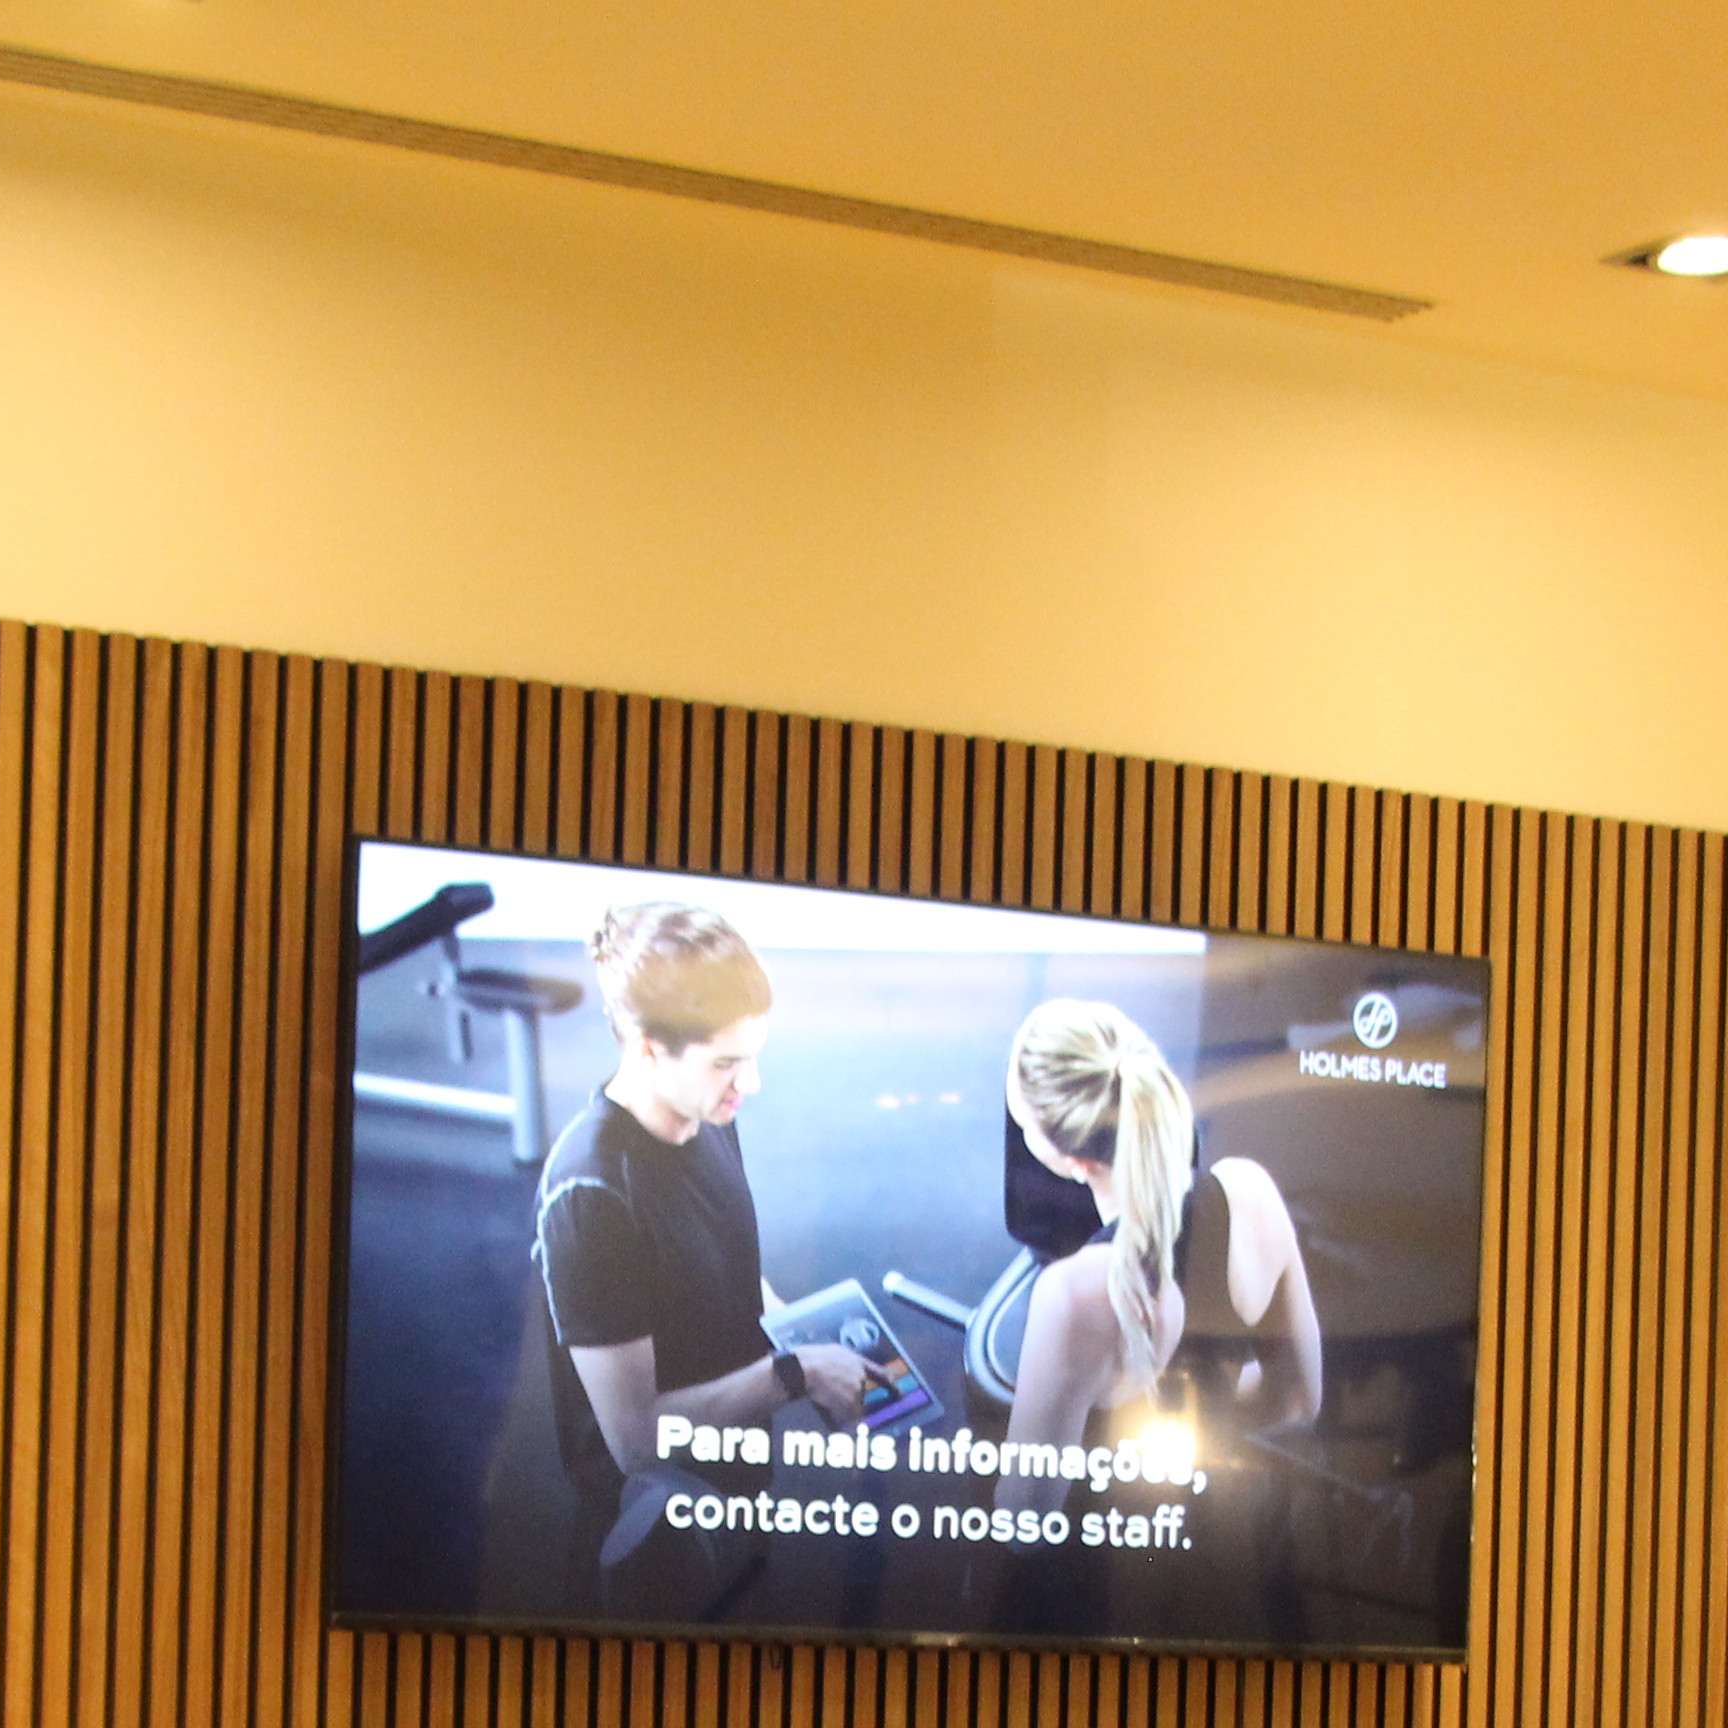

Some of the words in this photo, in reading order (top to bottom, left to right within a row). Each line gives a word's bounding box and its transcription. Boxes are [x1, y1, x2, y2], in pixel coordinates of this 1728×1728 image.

[1299, 1050, 1382, 1082] HOLMES
[1384, 1057, 1447, 1089] PLACE
[656, 1414, 770, 1465] Para
[783, 1422, 897, 1472] mais
[665, 1490, 880, 1537] contacte
[891, 1503, 921, 1539] o
[933, 1505, 1070, 1545] nosso
[1081, 1504, 1192, 1550] staff.
